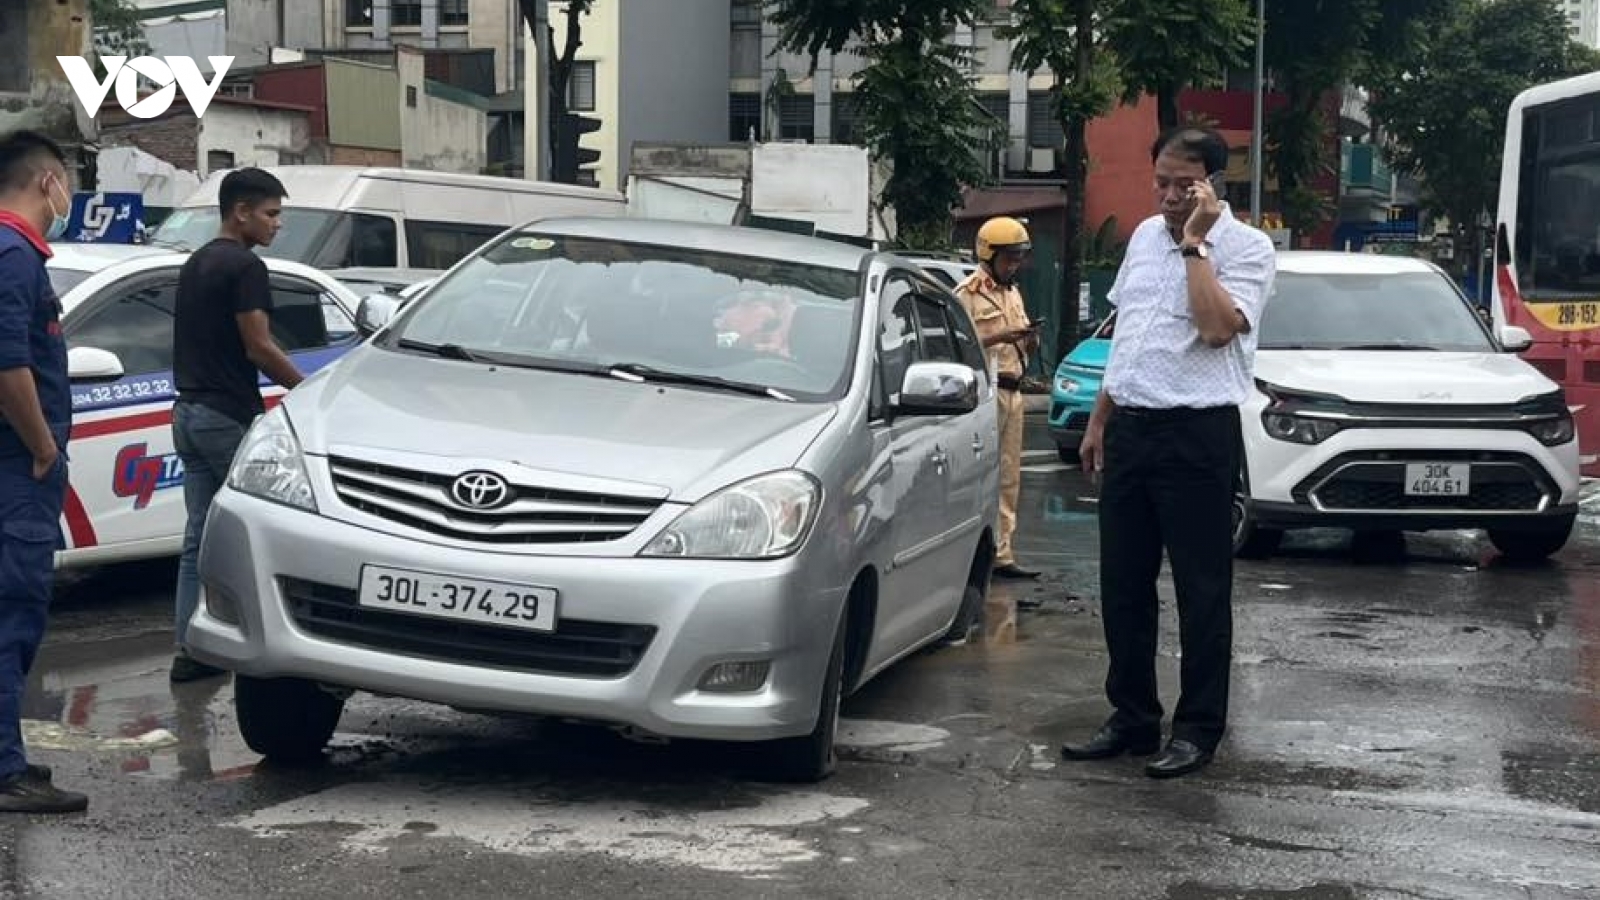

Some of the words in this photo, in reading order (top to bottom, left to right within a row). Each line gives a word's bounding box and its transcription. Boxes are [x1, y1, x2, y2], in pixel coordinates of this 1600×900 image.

[92, 386, 112, 402] 32
[112, 384, 133, 399] 32
[133, 381, 152, 396] 32
[152, 379, 171, 393] 32
[163, 455, 185, 478] TA
[1424, 464, 1451, 479] 30K
[377, 575, 538, 620] 30L-374.29
